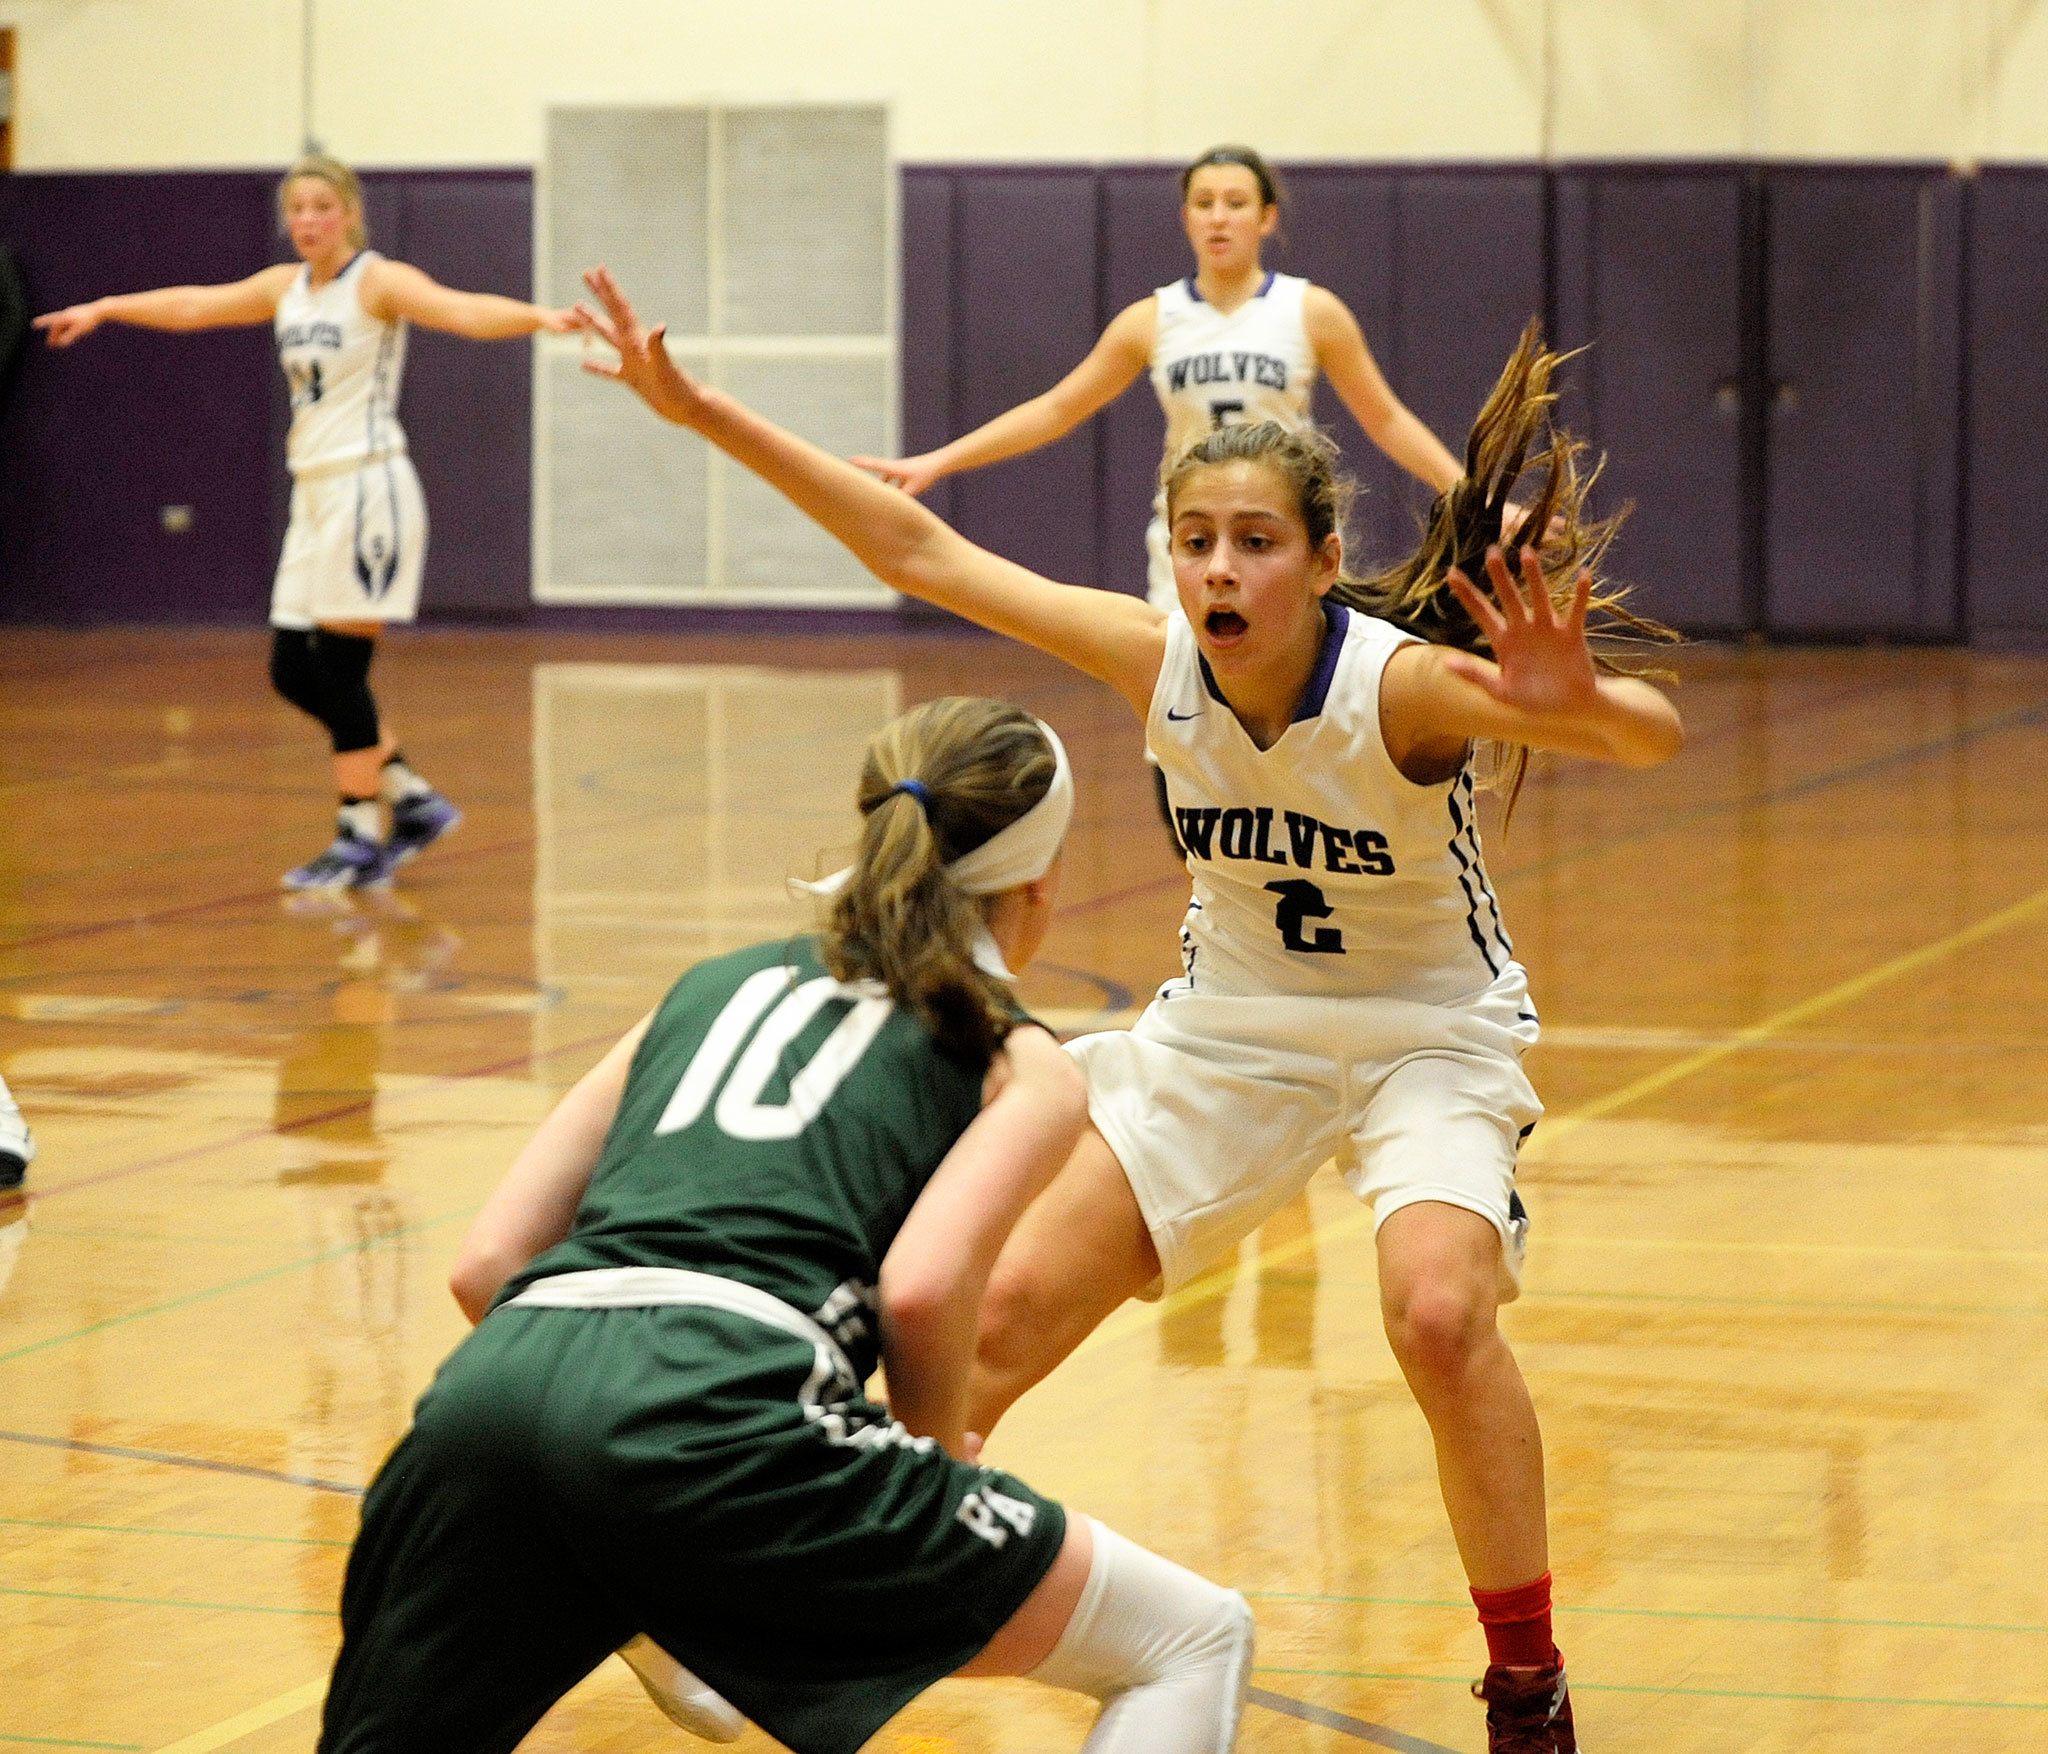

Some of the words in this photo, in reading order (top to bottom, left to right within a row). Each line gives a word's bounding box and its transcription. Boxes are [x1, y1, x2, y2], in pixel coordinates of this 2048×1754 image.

[1168, 352, 1287, 393] WOLVES
[1176, 806, 1396, 876] WOLVES
[1264, 878, 1346, 954] 2
[653, 965, 895, 1140] 10
